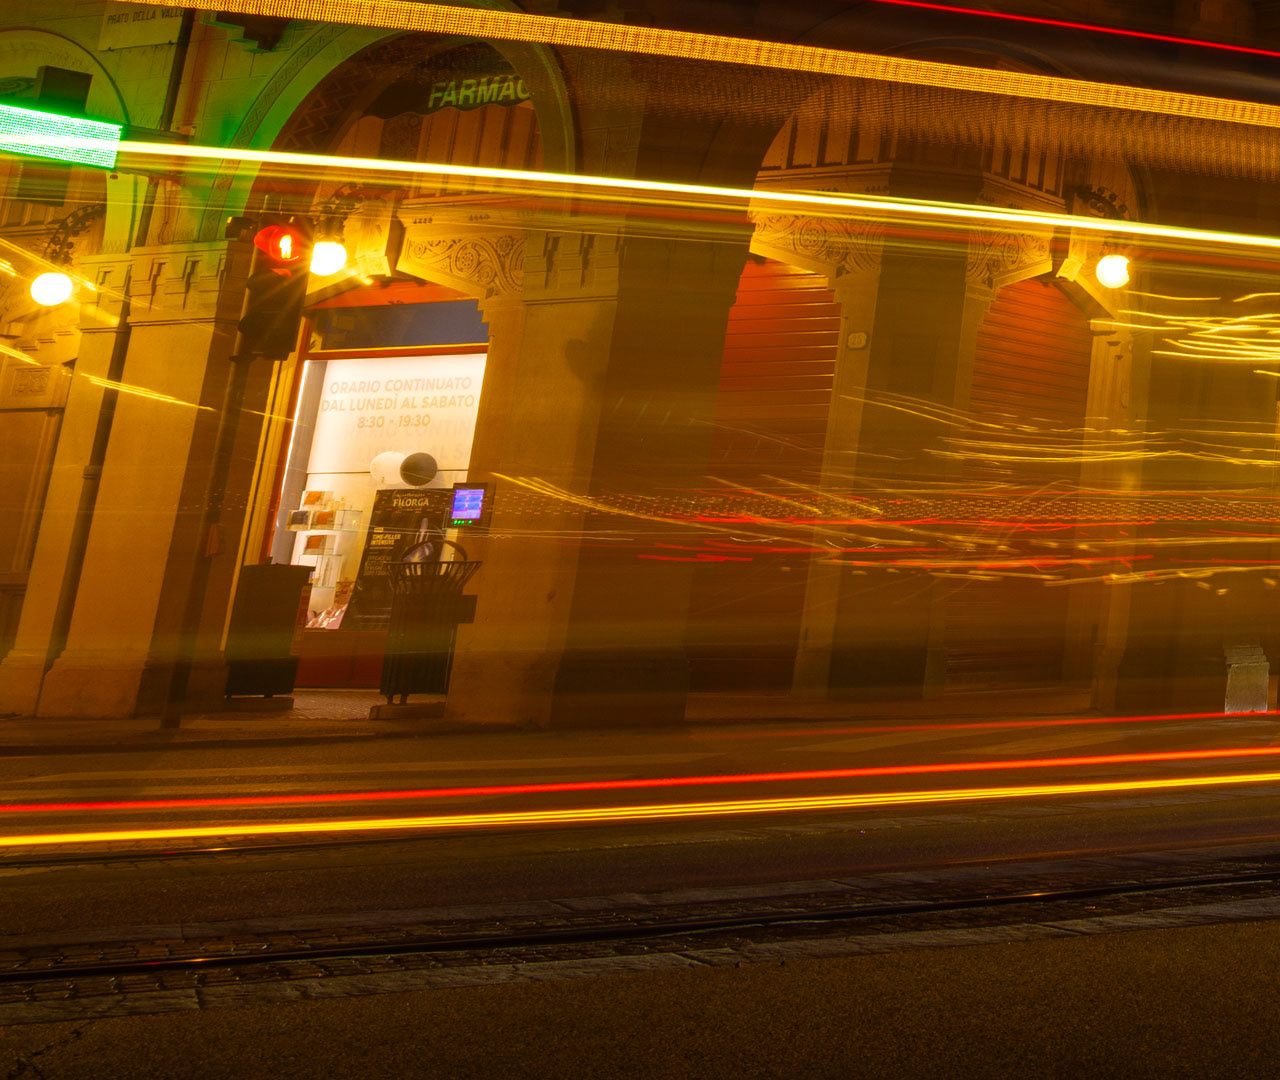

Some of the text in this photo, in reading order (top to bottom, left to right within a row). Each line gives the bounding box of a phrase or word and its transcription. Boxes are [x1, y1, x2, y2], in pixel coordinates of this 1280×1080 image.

[107, 13, 129, 24] PRATO
[132, 10, 156, 22] DELLA
[330, 377, 472, 394] ORARIO CONTINUATO
[321, 394, 475, 412] DAL LUNEDÌ AL SABATO
[357, 416, 385, 429] 8:30
[398, 414, 431, 428] 19:30
[393, 498, 429, 507] FILORGA
